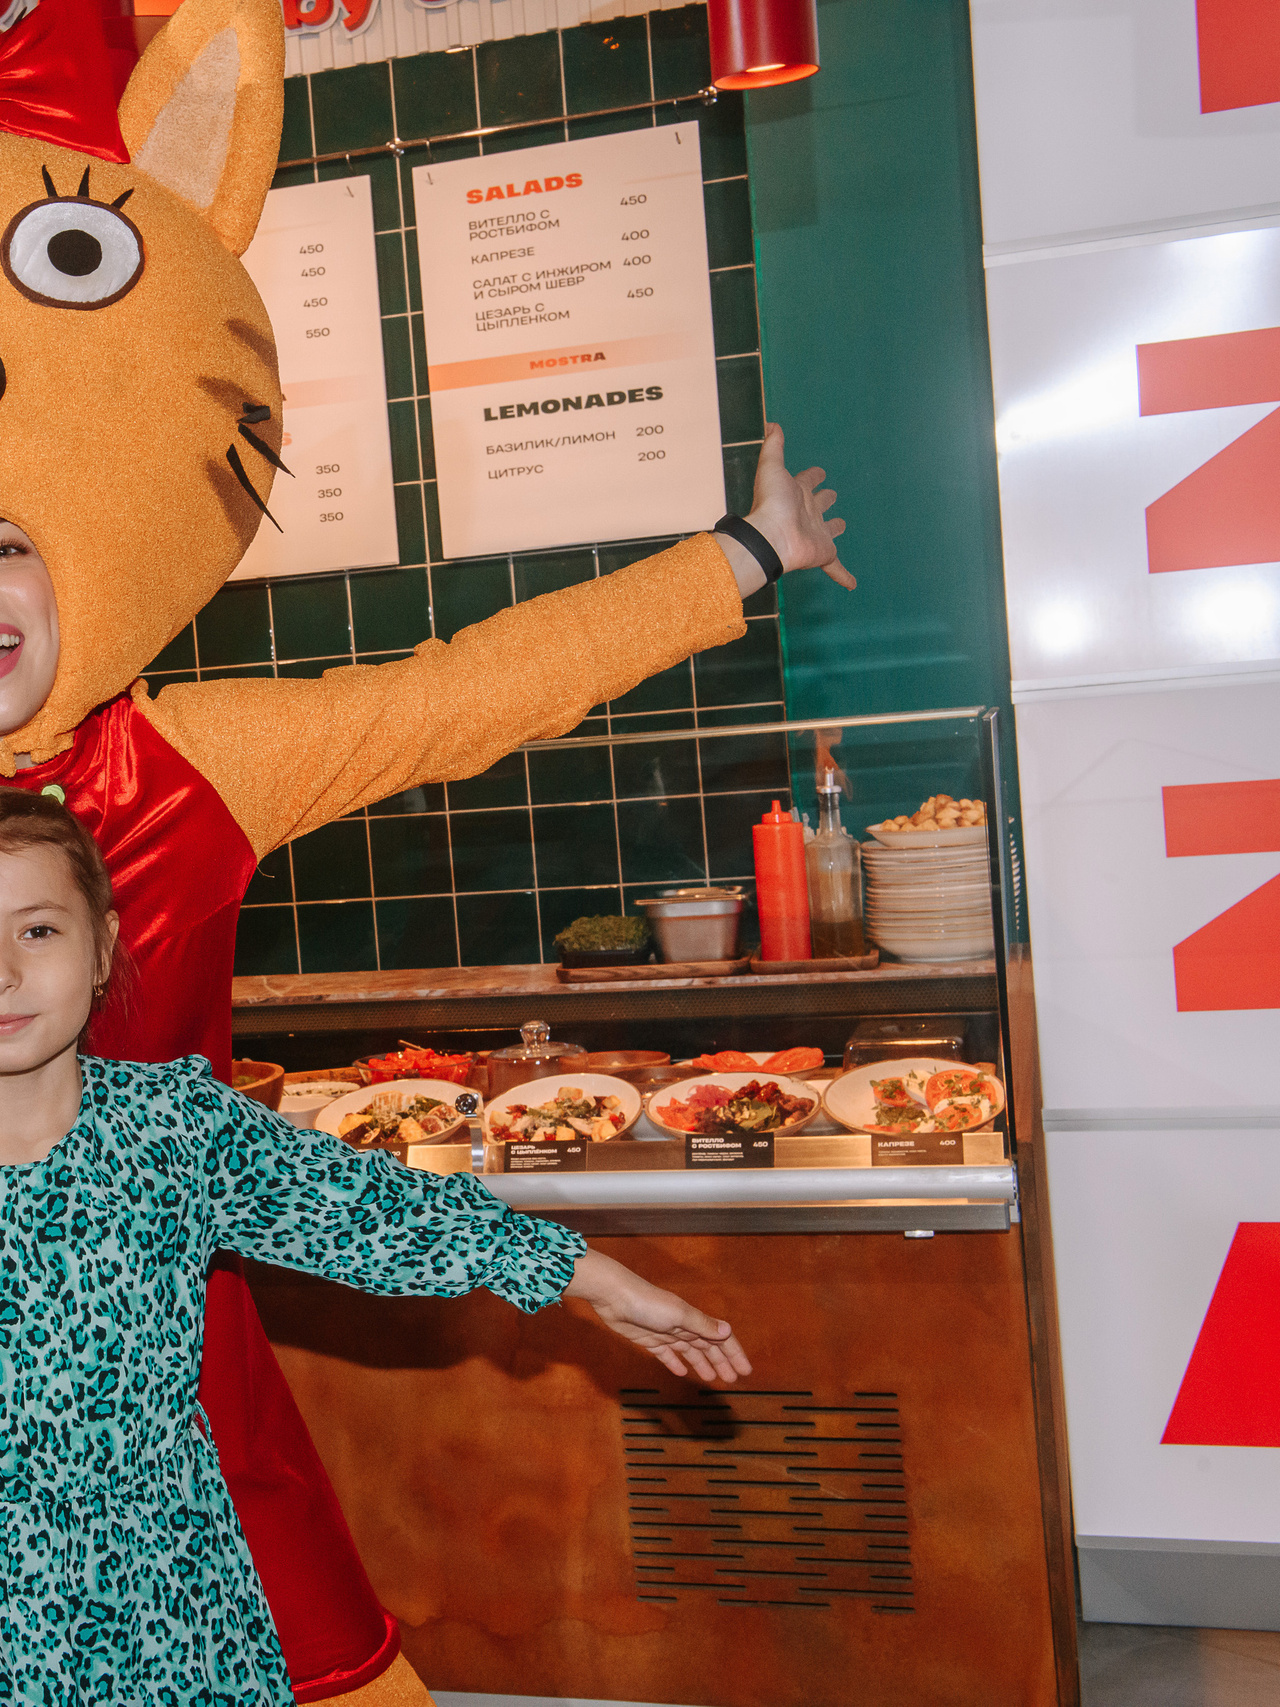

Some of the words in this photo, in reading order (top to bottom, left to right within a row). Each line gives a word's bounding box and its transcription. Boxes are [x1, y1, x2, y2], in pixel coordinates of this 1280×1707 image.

[466, 173, 583, 204] SALADS
[620, 194, 648, 206] 450
[468, 211, 536, 230] ВИТЕЛЛО
[539, 209, 551, 219] С
[469, 219, 560, 241] РОСТБИФОМ
[621, 229, 650, 241] 400
[299, 243, 324, 255] 450
[471, 247, 535, 265] КАПРЕЗЕ
[623, 254, 652, 267] 400
[300, 266, 326, 278] 450
[472, 274, 518, 290] САЛАТ
[521, 272, 533, 283] С
[535, 260, 612, 280] ИНЖИРОМ
[473, 290, 485, 300] И
[488, 282, 541, 299] СЫРОМ
[545, 275, 585, 290] ШЕВР
[627, 287, 654, 299] 450
[303, 297, 328, 308] 450
[475, 305, 531, 322] ЦЕЗАРЬ
[534, 303, 546, 313] С
[476, 310, 570, 332] ЦЫПЛЕНКОМ
[305, 327, 330, 339] 550
[529, 352, 606, 371] MOSTRA
[483, 385, 664, 422] LEMONADES
[636, 425, 664, 437] 200
[486, 430, 616, 455] БАЗИЛИК/ЛИМОН
[637, 450, 666, 462] 200
[315, 463, 340, 475] 350
[488, 464, 544, 480] ЦИТРУС
[317, 487, 342, 499] 350
[319, 511, 344, 523] 350
